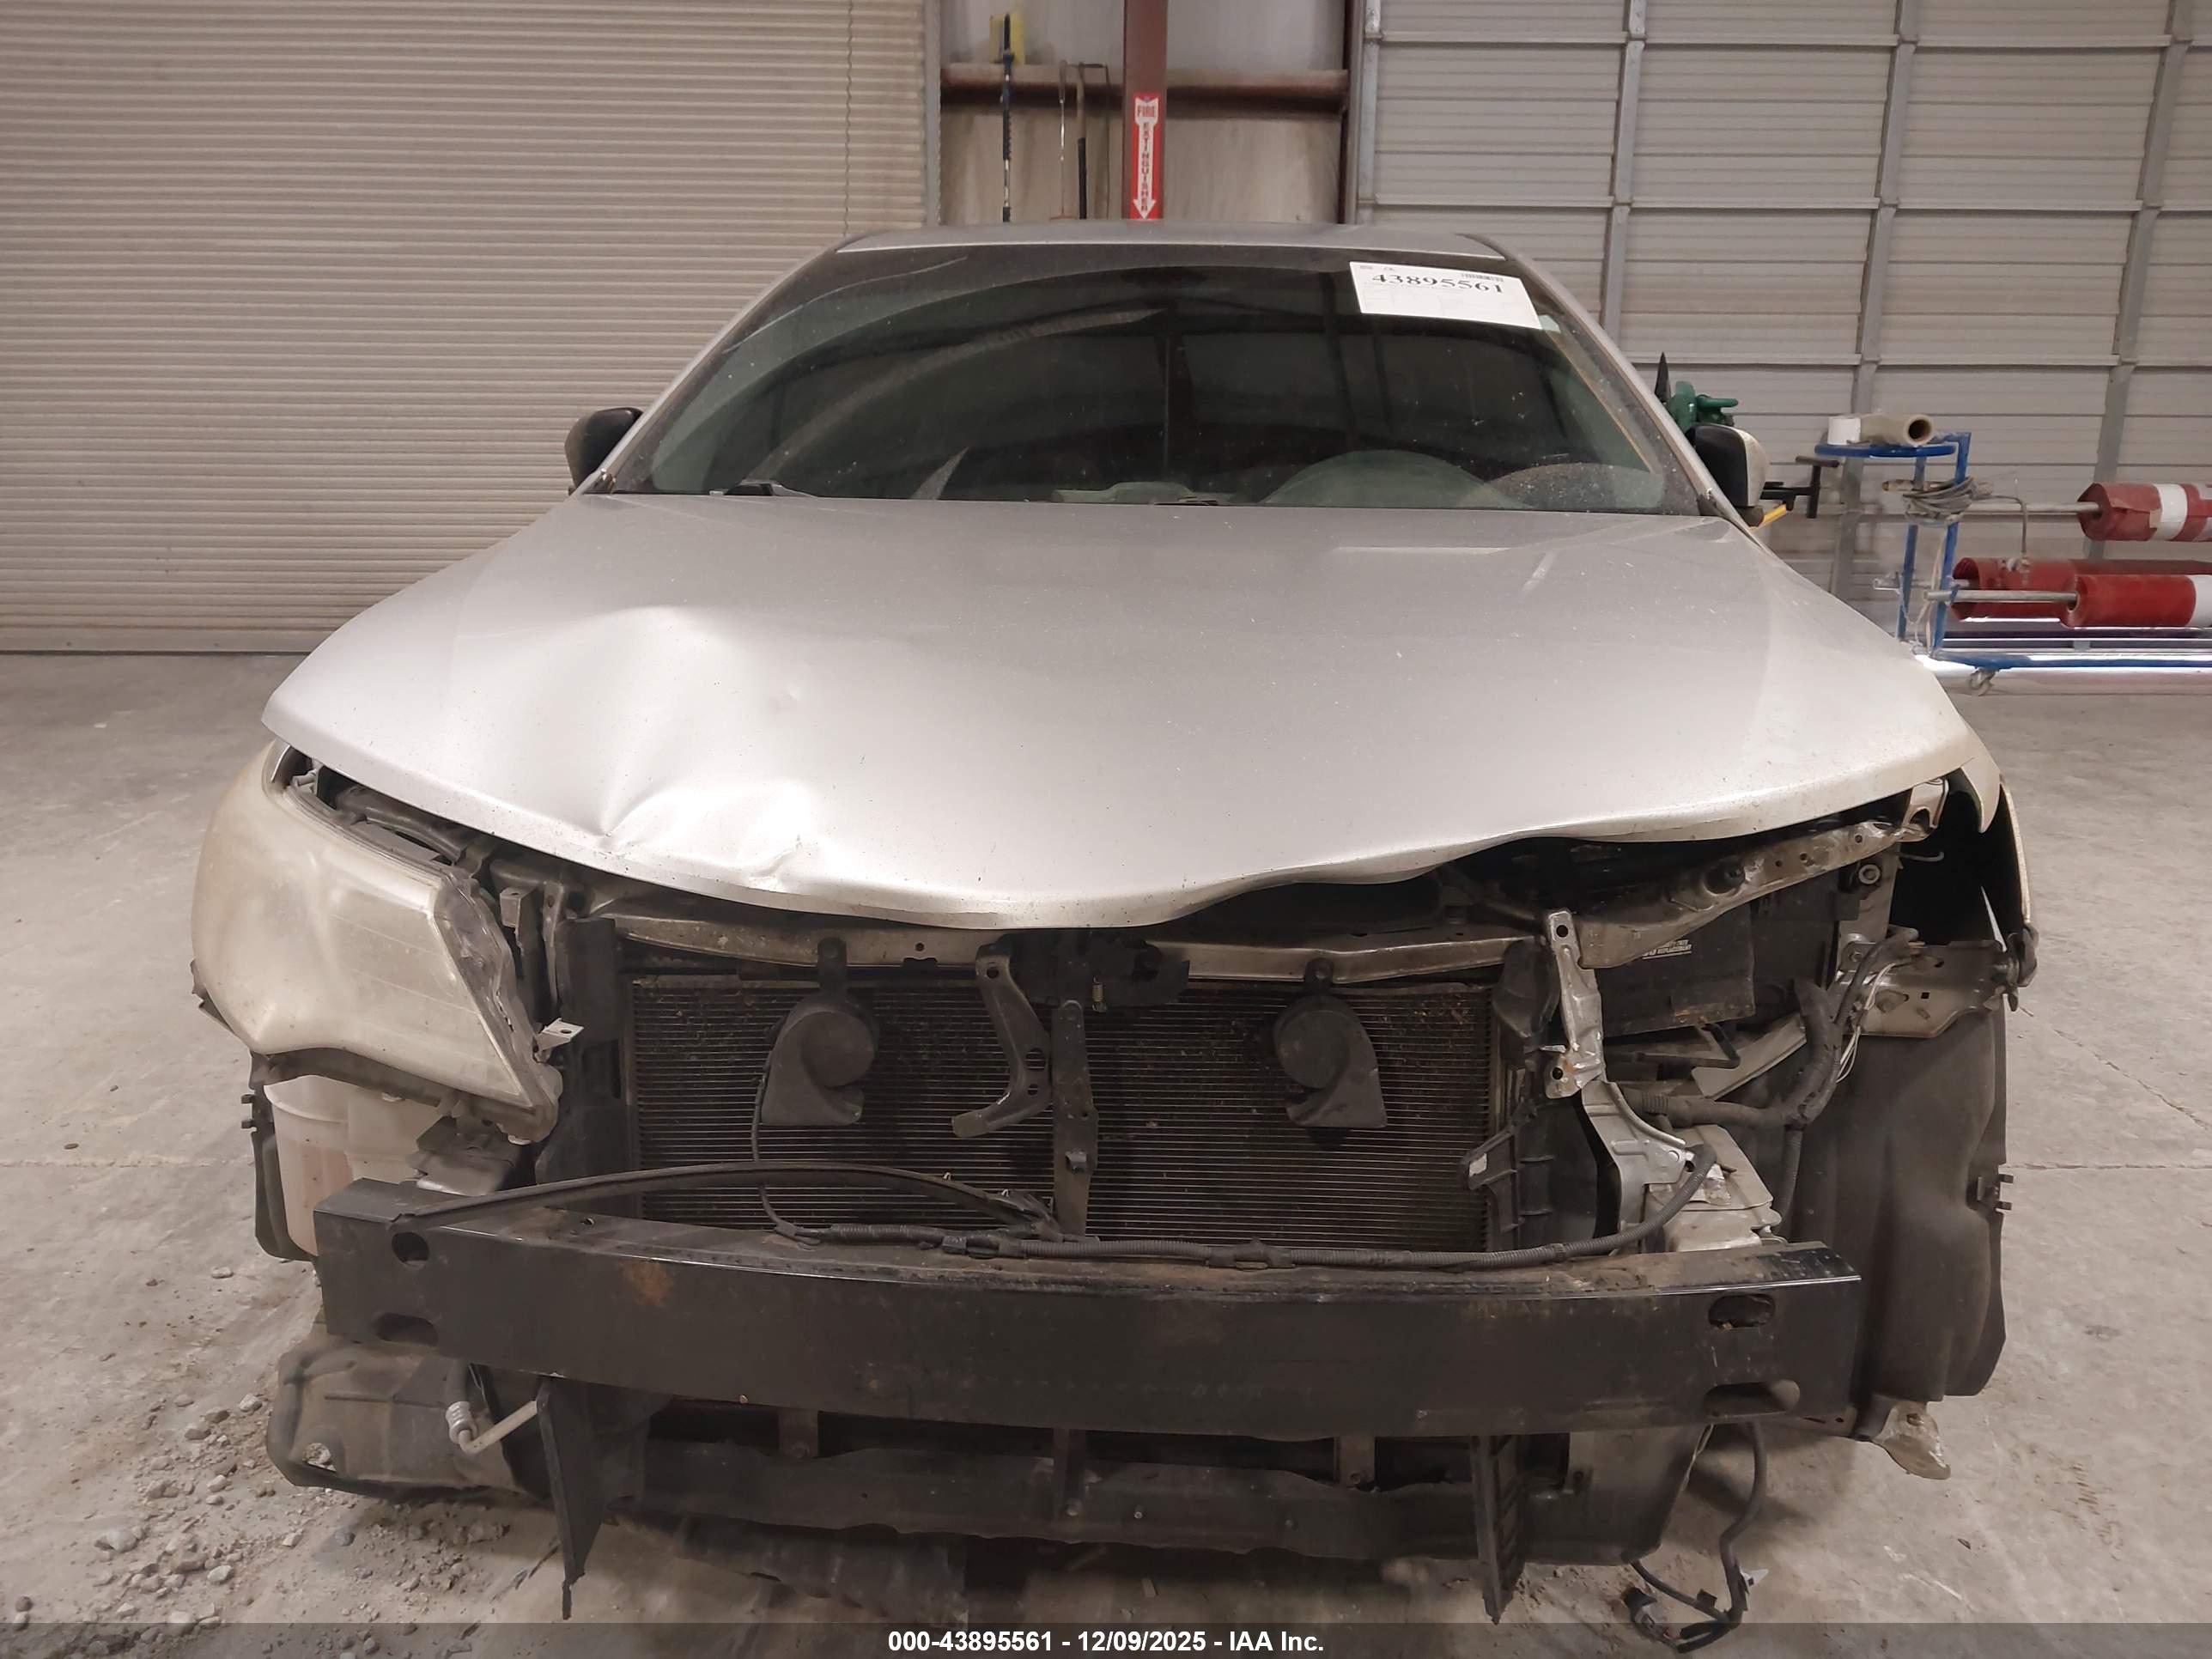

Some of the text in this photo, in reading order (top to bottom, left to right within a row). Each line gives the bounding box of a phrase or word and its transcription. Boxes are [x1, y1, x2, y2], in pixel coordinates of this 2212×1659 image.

[1137, 106, 1155, 118] FIRE
[1140, 122, 1150, 212] EXTINGUISHER
[1372, 273, 1504, 294] 43895561
